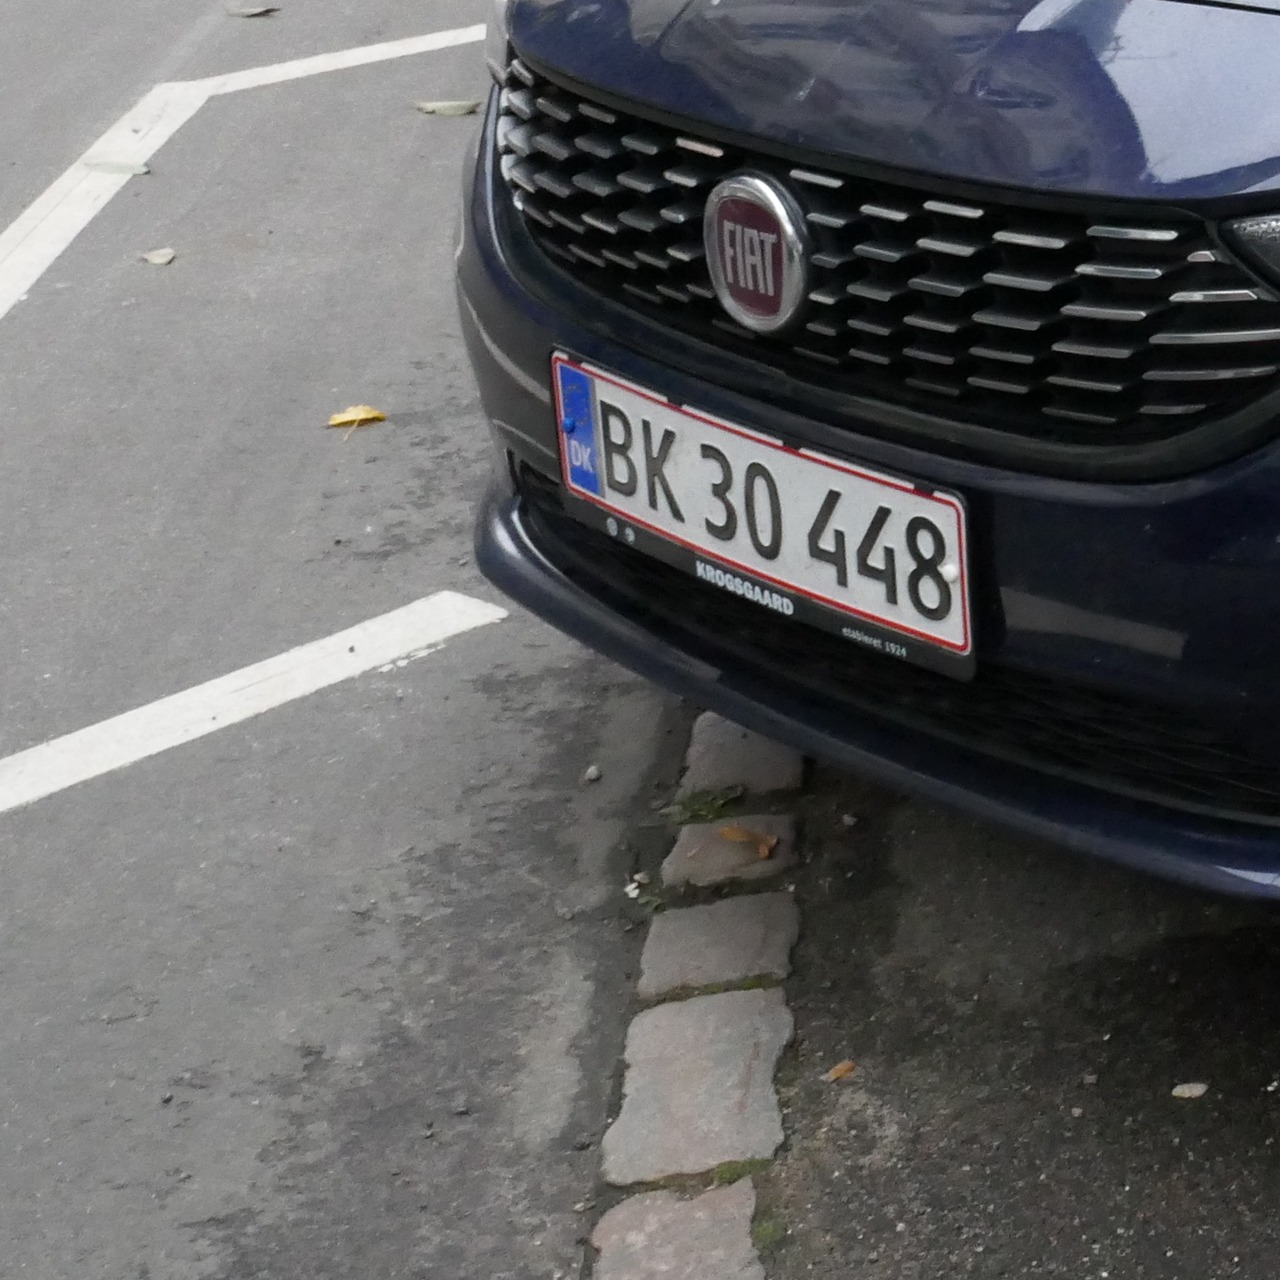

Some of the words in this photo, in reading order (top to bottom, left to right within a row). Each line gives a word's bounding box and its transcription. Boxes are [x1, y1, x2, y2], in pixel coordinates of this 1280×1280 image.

[723, 219, 778, 297] FIAT
[570, 439, 593, 473] DK
[599, 398, 686, 525] BK
[700, 442, 783, 562] 30
[807, 488, 953, 622] 448
[695, 560, 794, 616] KROGSGAARD
[885, 640, 907, 658] 1924
